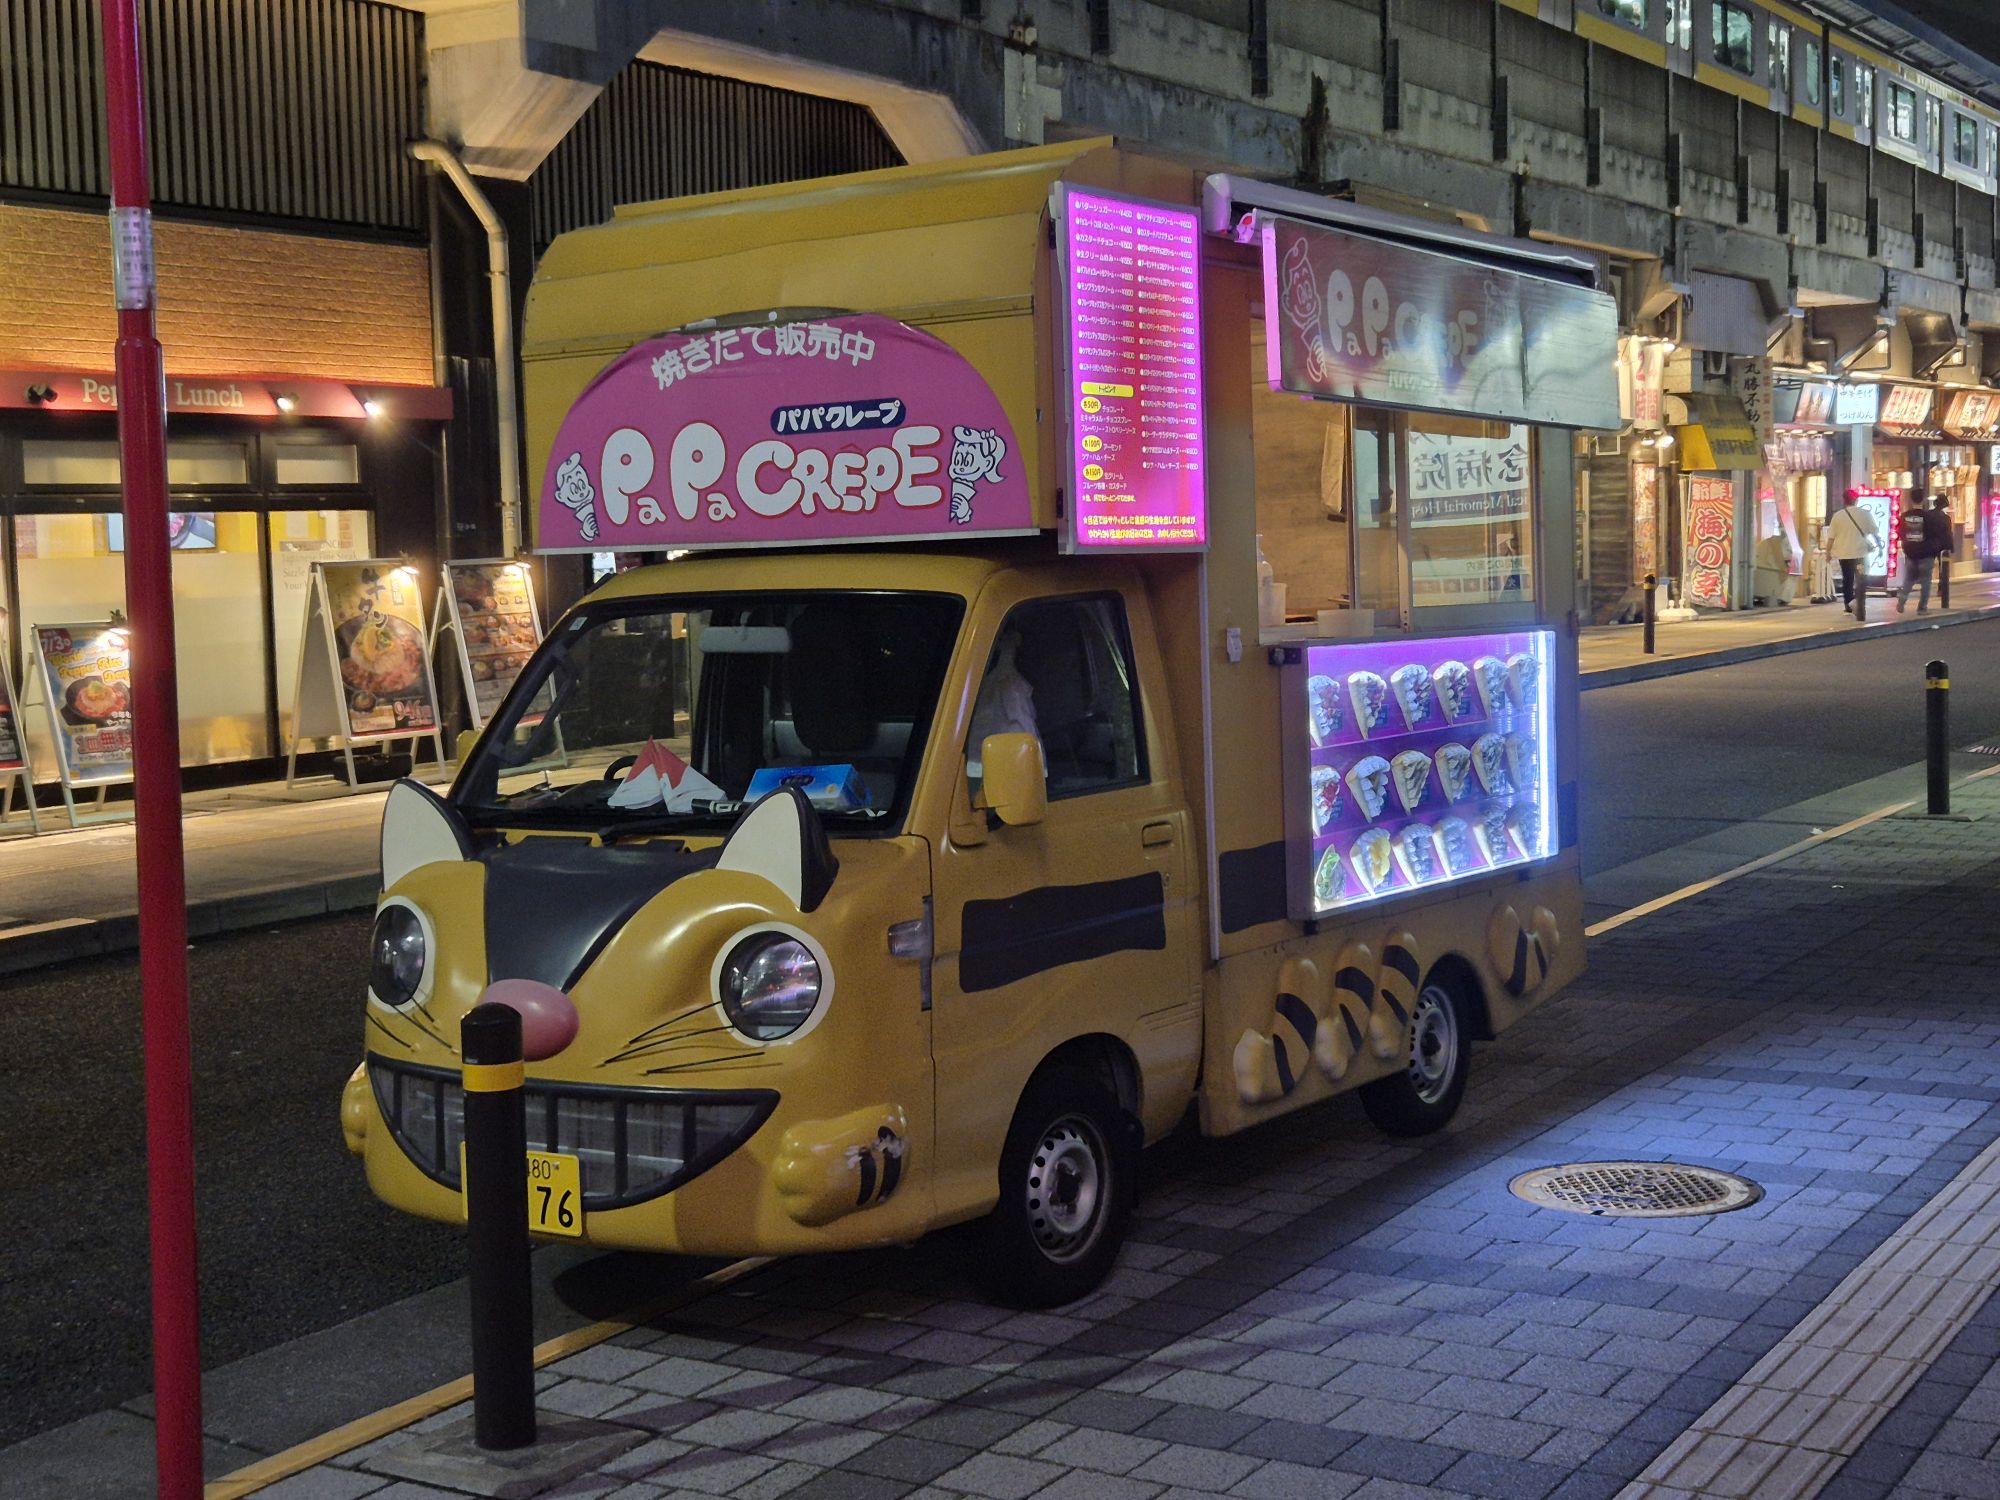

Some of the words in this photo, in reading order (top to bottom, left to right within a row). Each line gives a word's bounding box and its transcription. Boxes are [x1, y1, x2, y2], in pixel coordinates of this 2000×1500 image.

[651, 322, 875, 391] 焼きたて販売中
[175, 382, 245, 407] Lunch
[776, 400, 901, 432] パパクレープ
[1692, 508, 1728, 599] 海の幸
[536, 1185, 574, 1228] 76
